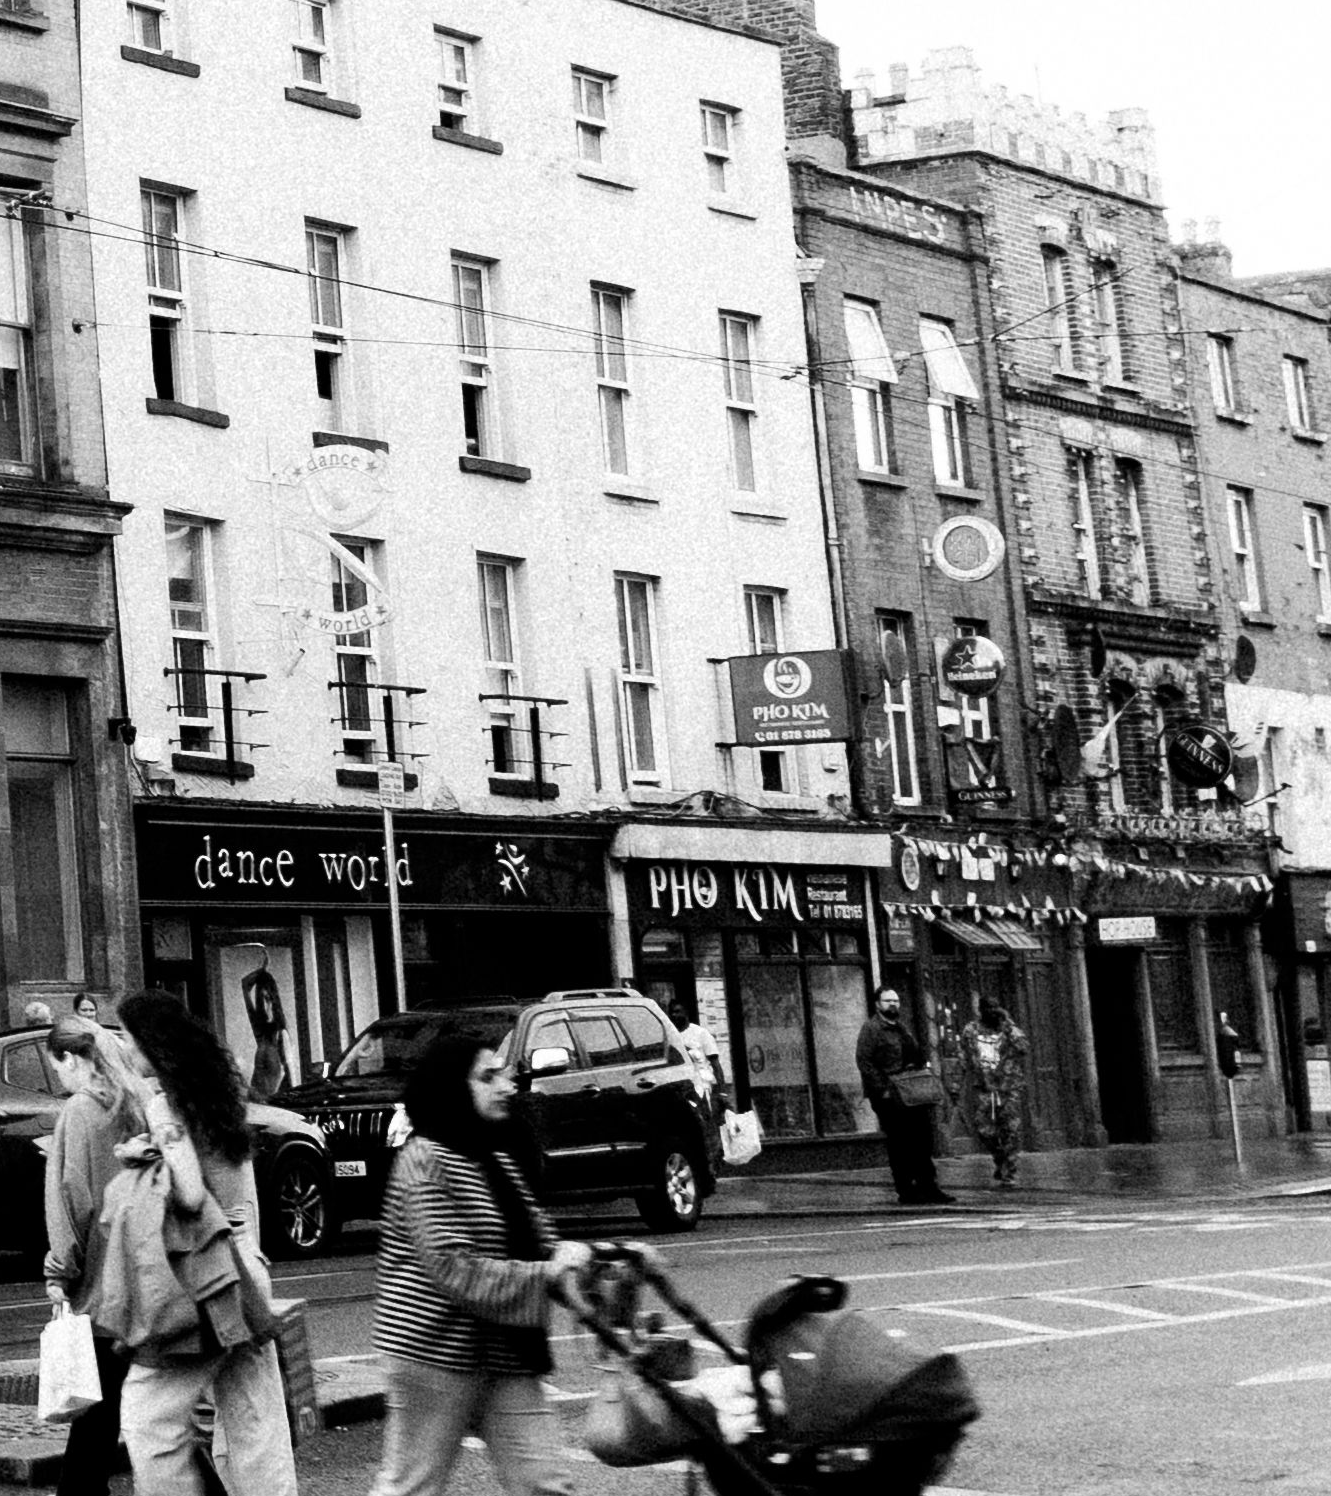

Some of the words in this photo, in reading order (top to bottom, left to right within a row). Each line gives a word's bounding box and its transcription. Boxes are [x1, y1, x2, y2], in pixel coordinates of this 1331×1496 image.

[306, 452, 361, 472] dance
[318, 610, 372, 633] world
[946, 670, 997, 681] Heineken
[752, 703, 790, 722] PHO
[791, 702, 831, 721] KIM
[1176, 736, 1225, 776] GUINNESS
[958, 791, 1008, 801] GUINNESS
[195, 835, 295, 888] dance
[649, 865, 718, 917] PHO
[734, 865, 804, 921] KIM
